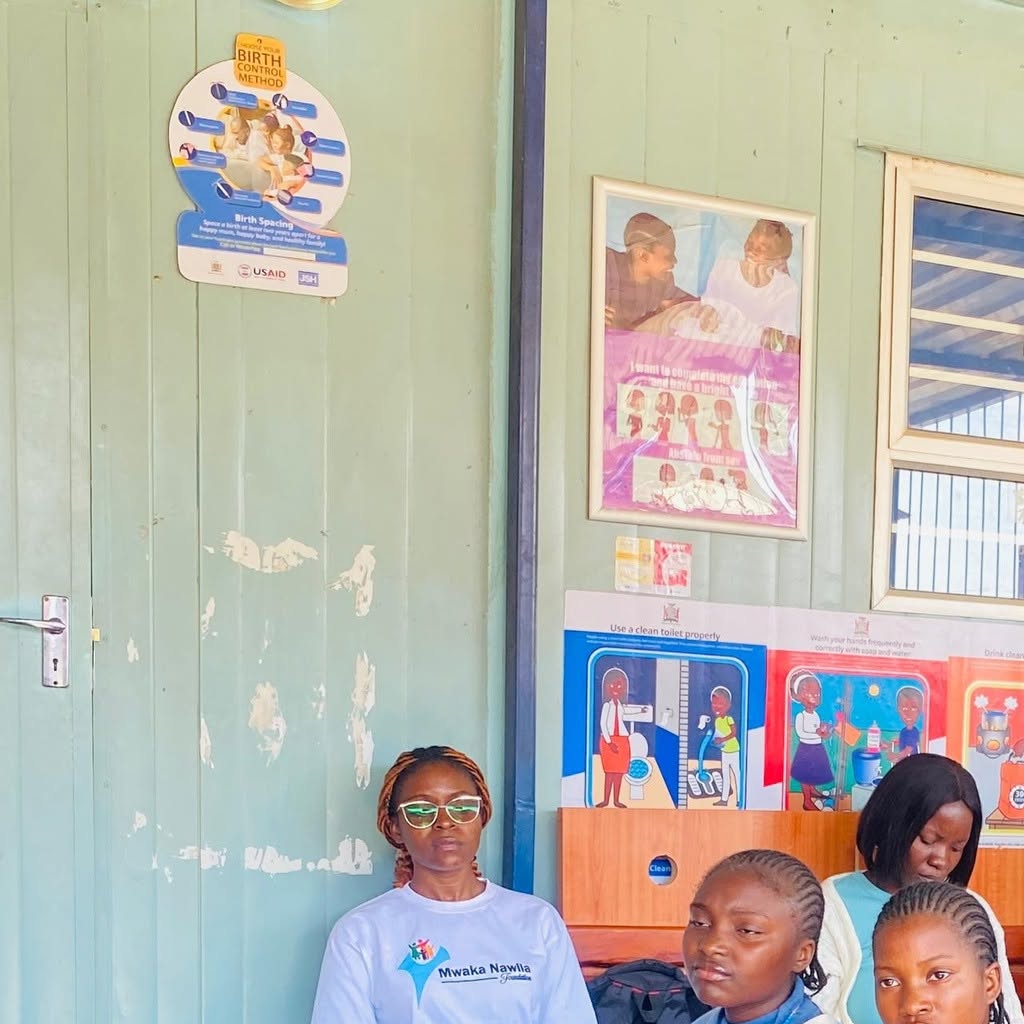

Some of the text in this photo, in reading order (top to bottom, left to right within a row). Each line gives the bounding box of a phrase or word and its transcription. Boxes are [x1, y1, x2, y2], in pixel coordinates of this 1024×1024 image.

[238, 49, 281, 68] BIRTH
[237, 62, 284, 78] CONTROL
[238, 73, 283, 88] METHOD
[235, 214, 294, 230] Birth Spacing
[253, 267, 286, 279] USAID
[610, 624, 627, 633] Use
[635, 626, 659, 636] clean
[660, 628, 683, 638] toilet
[685, 631, 721, 642] properly
[810, 634, 830, 642] Wash
[845, 646, 861, 654] with
[984, 649, 1004, 657] Drink
[438, 965, 486, 978] Mwaka
